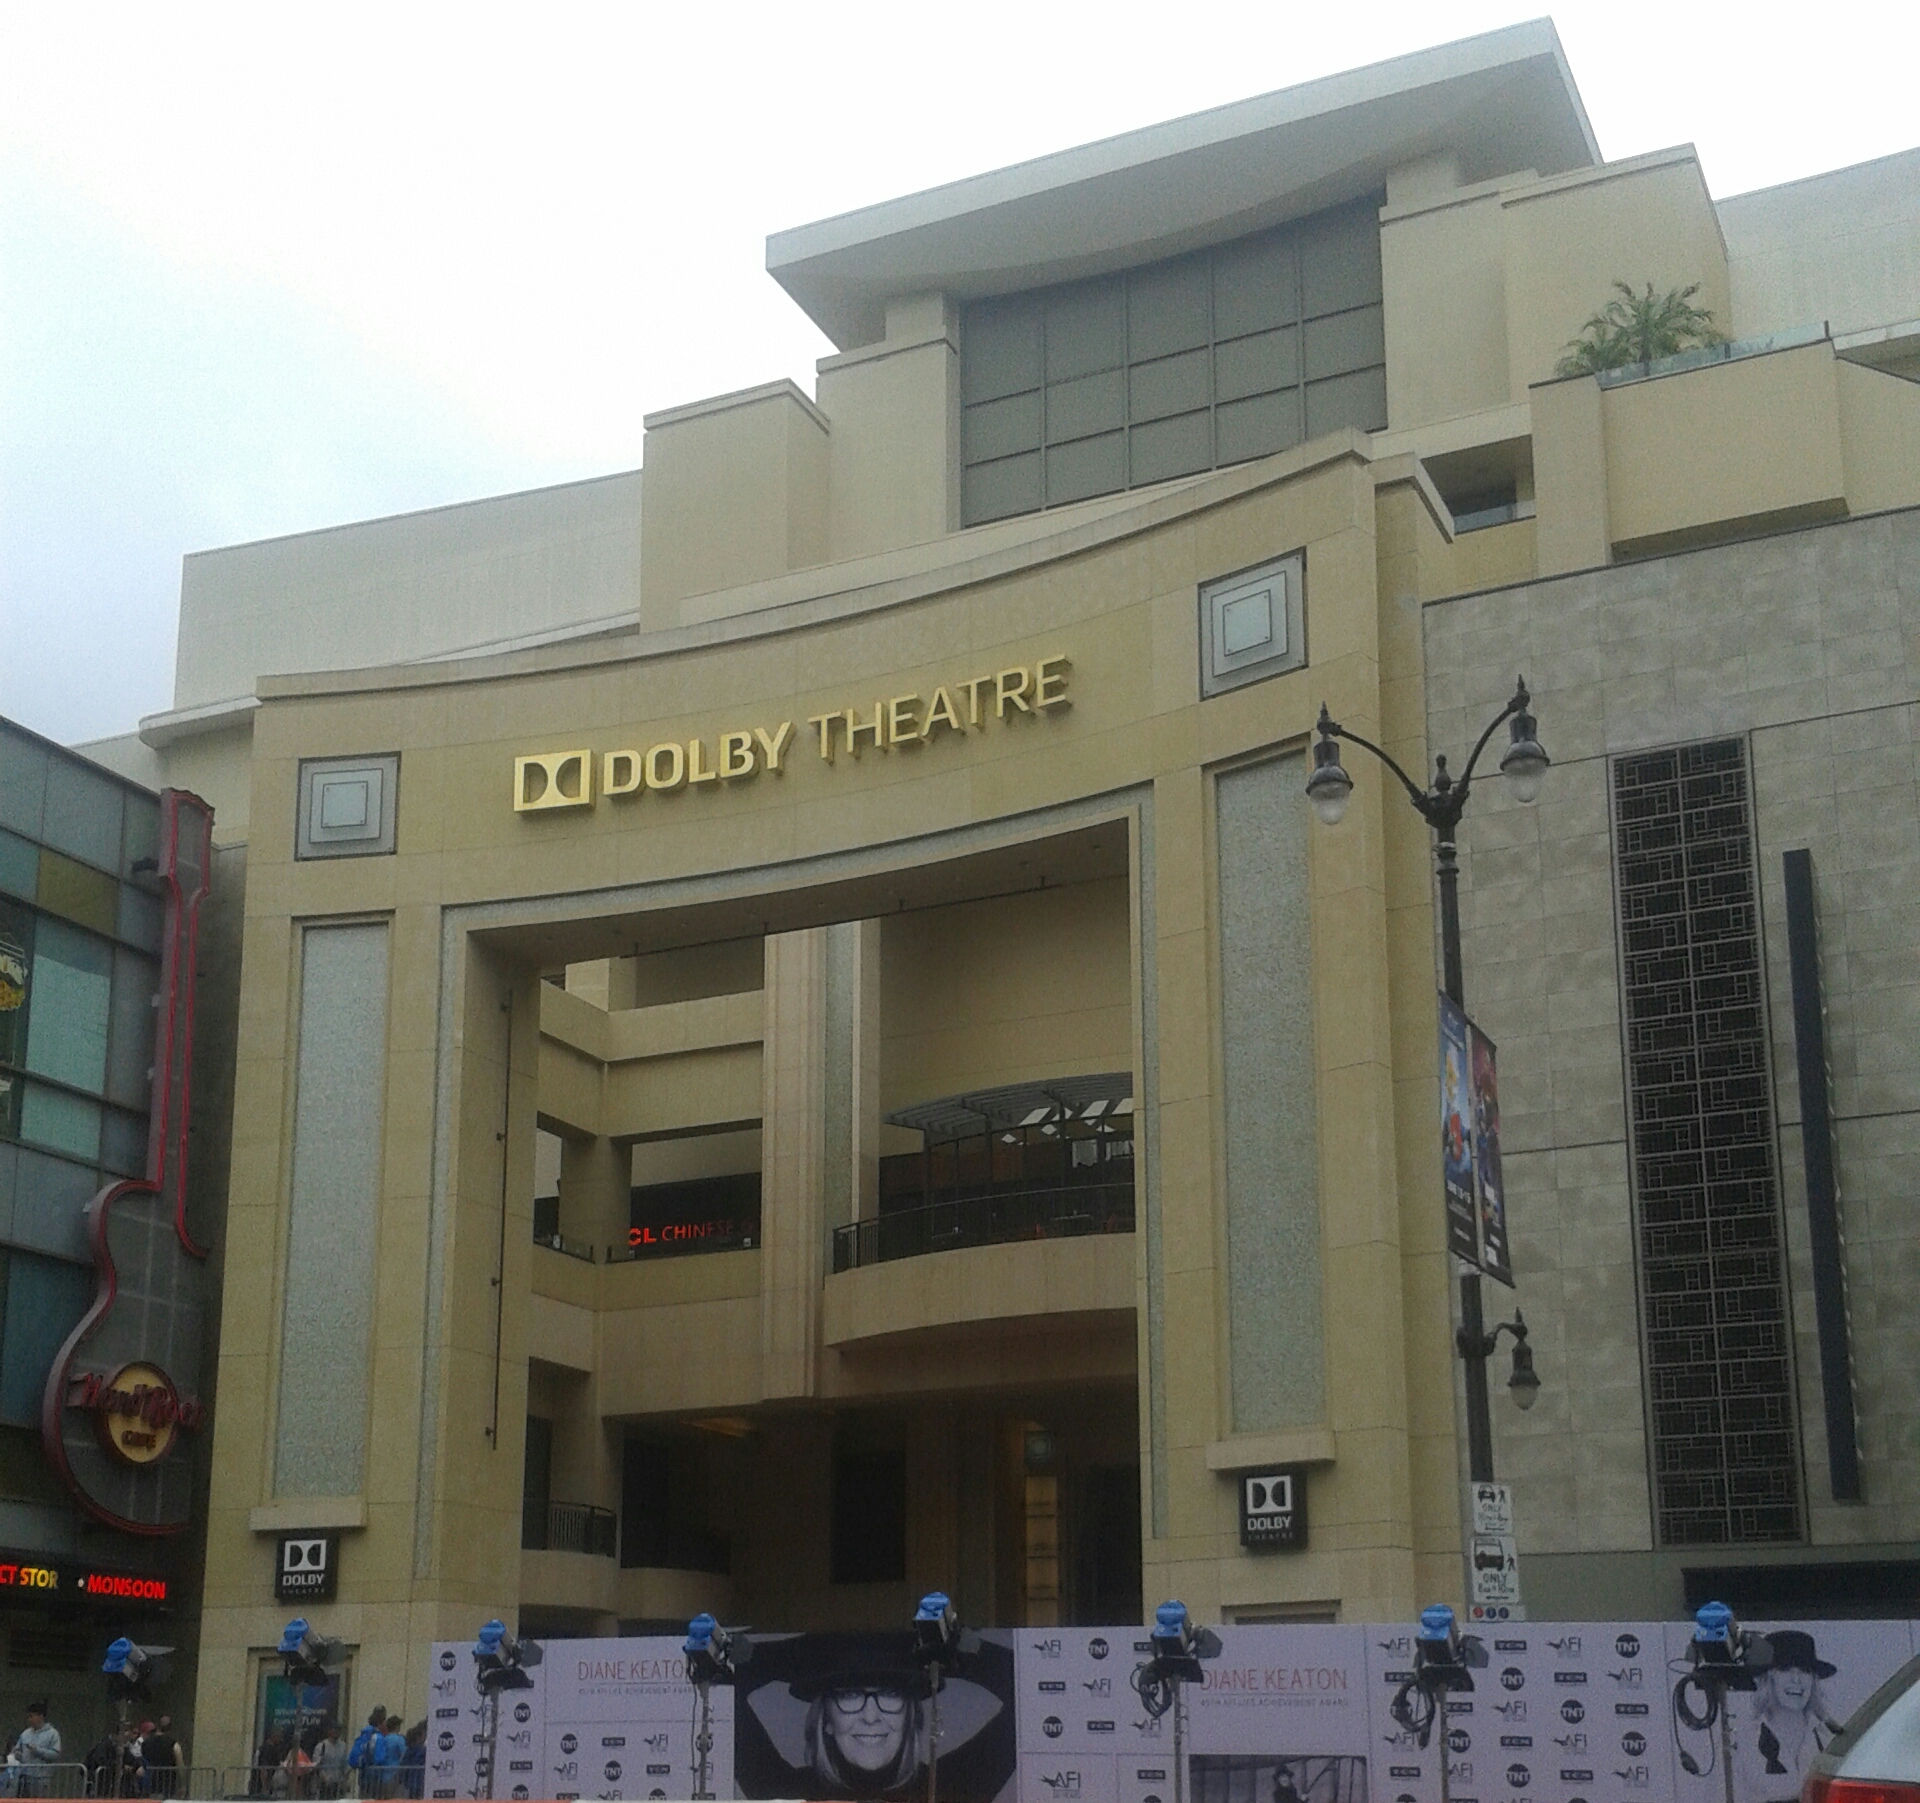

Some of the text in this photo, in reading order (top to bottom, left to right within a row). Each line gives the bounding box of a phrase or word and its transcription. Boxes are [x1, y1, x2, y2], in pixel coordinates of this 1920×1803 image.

[602, 653, 1072, 797] DOLBY THEATRE
[1247, 1516, 1292, 1531] DOLBY
[88, 1574, 166, 1599] MONSOON
[282, 1574, 325, 1586] DOLBY
[578, 1661, 626, 1680] DIANE
[1201, 1668, 1348, 1690] DIANE KEATON
[1054, 1771, 1080, 1788] AFI
